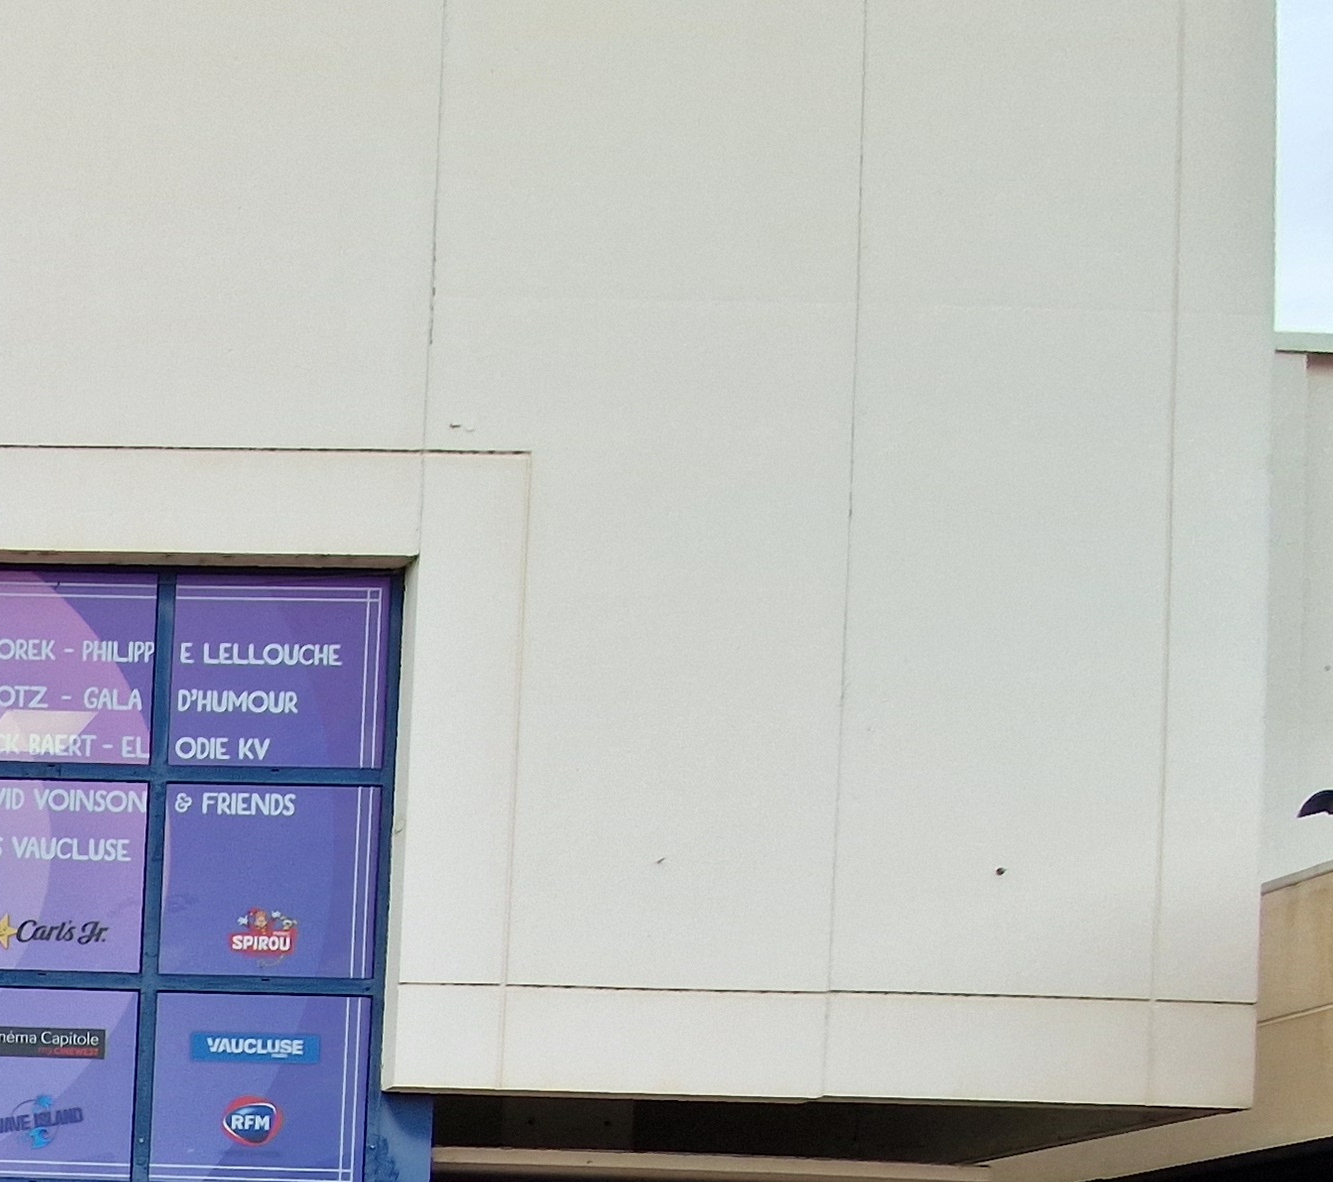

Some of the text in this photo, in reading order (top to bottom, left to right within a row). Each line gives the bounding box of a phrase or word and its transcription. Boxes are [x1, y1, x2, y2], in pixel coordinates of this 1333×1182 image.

[203, 642, 343, 667] LELLOUCHE
[83, 687, 143, 711] GALA
[177, 688, 299, 714] D'HUMOUR
[28, 733, 97, 757] BAERT
[238, 737, 271, 760] KV
[33, 788, 148, 813] VOINSON
[174, 792, 193, 813] &
[202, 792, 297, 817] FRIENDS
[11, 836, 132, 862] VAUCLUSE
[16, 919, 110, 945] Carl's Jr.
[232, 935, 291, 951] SPIROU
[41, 1031, 100, 1048] Capitole
[206, 1038, 304, 1055] VAUCLUSE
[231, 1115, 270, 1130] RFM
